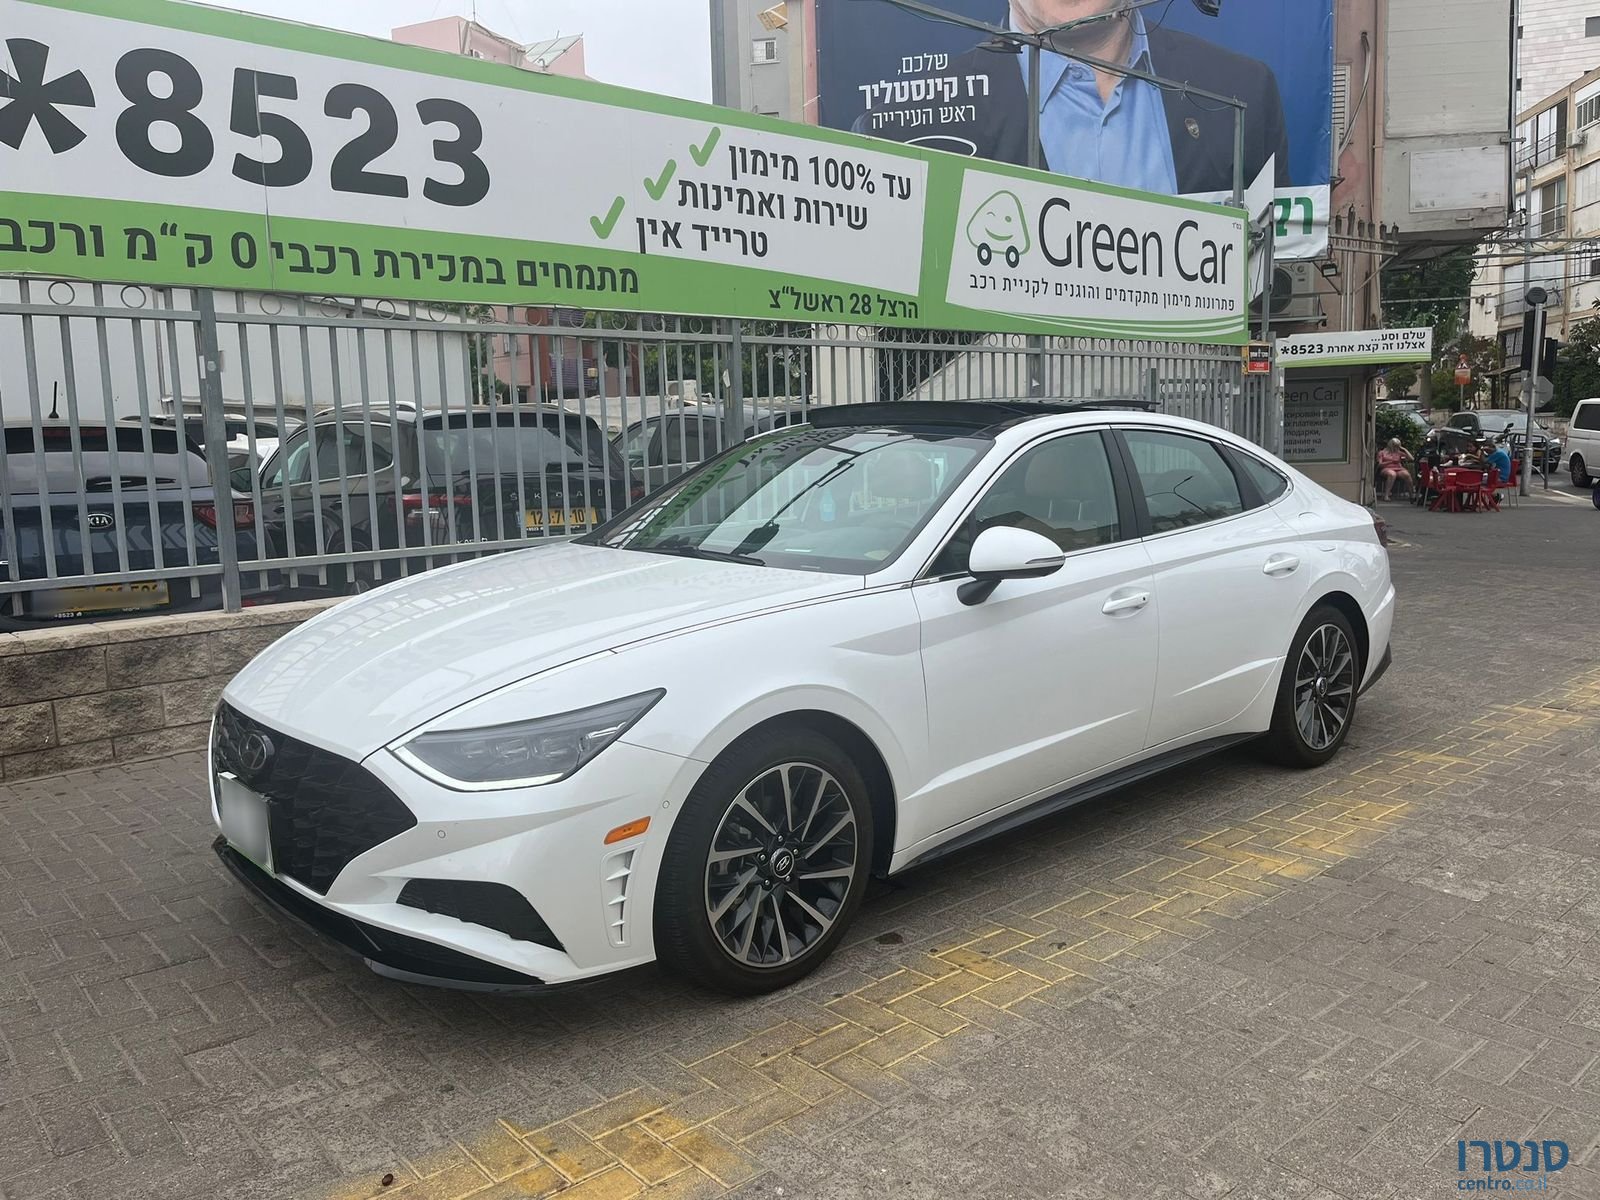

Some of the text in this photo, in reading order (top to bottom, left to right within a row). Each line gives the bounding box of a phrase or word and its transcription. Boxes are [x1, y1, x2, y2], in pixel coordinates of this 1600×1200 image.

[897, 53, 948, 75] שלכם,
[858, 74, 989, 110] רז קינסטליך
[872, 104, 976, 130] ראש העירייה
[728, 145, 911, 200] עד 100% מימון
[678, 179, 868, 231] שירות ואמינות
[230, 231, 258, 269] 0
[636, 217, 768, 257] טרייד אין
[1038, 197, 1233, 285] Green Car
[271, 241, 361, 277] רכבי
[374, 249, 506, 286] במכירת
[516, 260, 639, 294] מתמחים
[850, 292, 872, 315] 28
[877, 294, 918, 319] הרצל
[969, 273, 1235, 312] פתרונות מימון מתקדמים והוגנים לקניית רכב
[1326, 345, 1354, 354] אחרת
[1357, 343, 1379, 353] קצת
[1371, 331, 1426, 342] שלם וסע...
[1382, 342, 1394, 350] זה
[1396, 340, 1425, 350] אצלנו
[1313, 386, 1340, 401] Car
